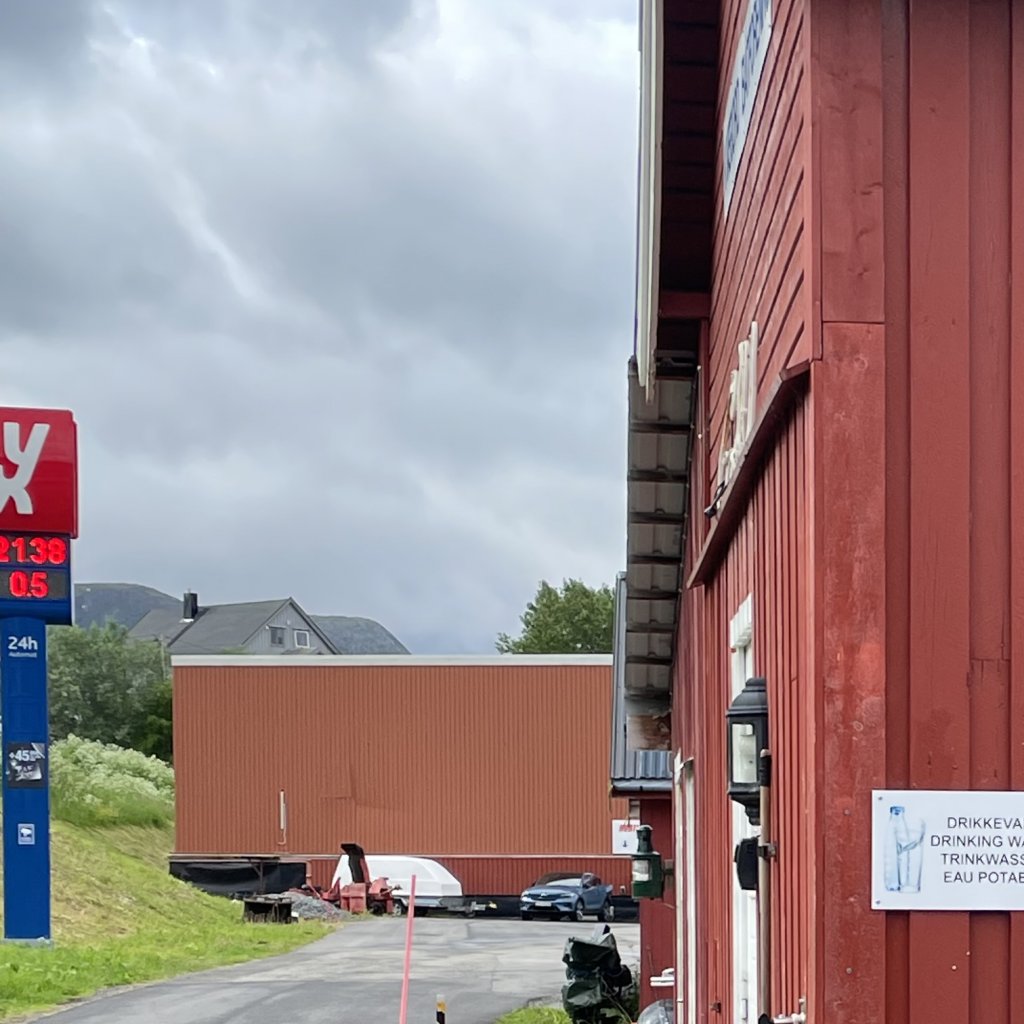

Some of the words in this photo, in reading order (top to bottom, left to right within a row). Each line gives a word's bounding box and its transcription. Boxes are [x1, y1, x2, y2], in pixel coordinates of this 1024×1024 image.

[8, 636, 38, 650] 24h
[930, 834, 1003, 848] DRINKING
[943, 871, 974, 883] EAU
